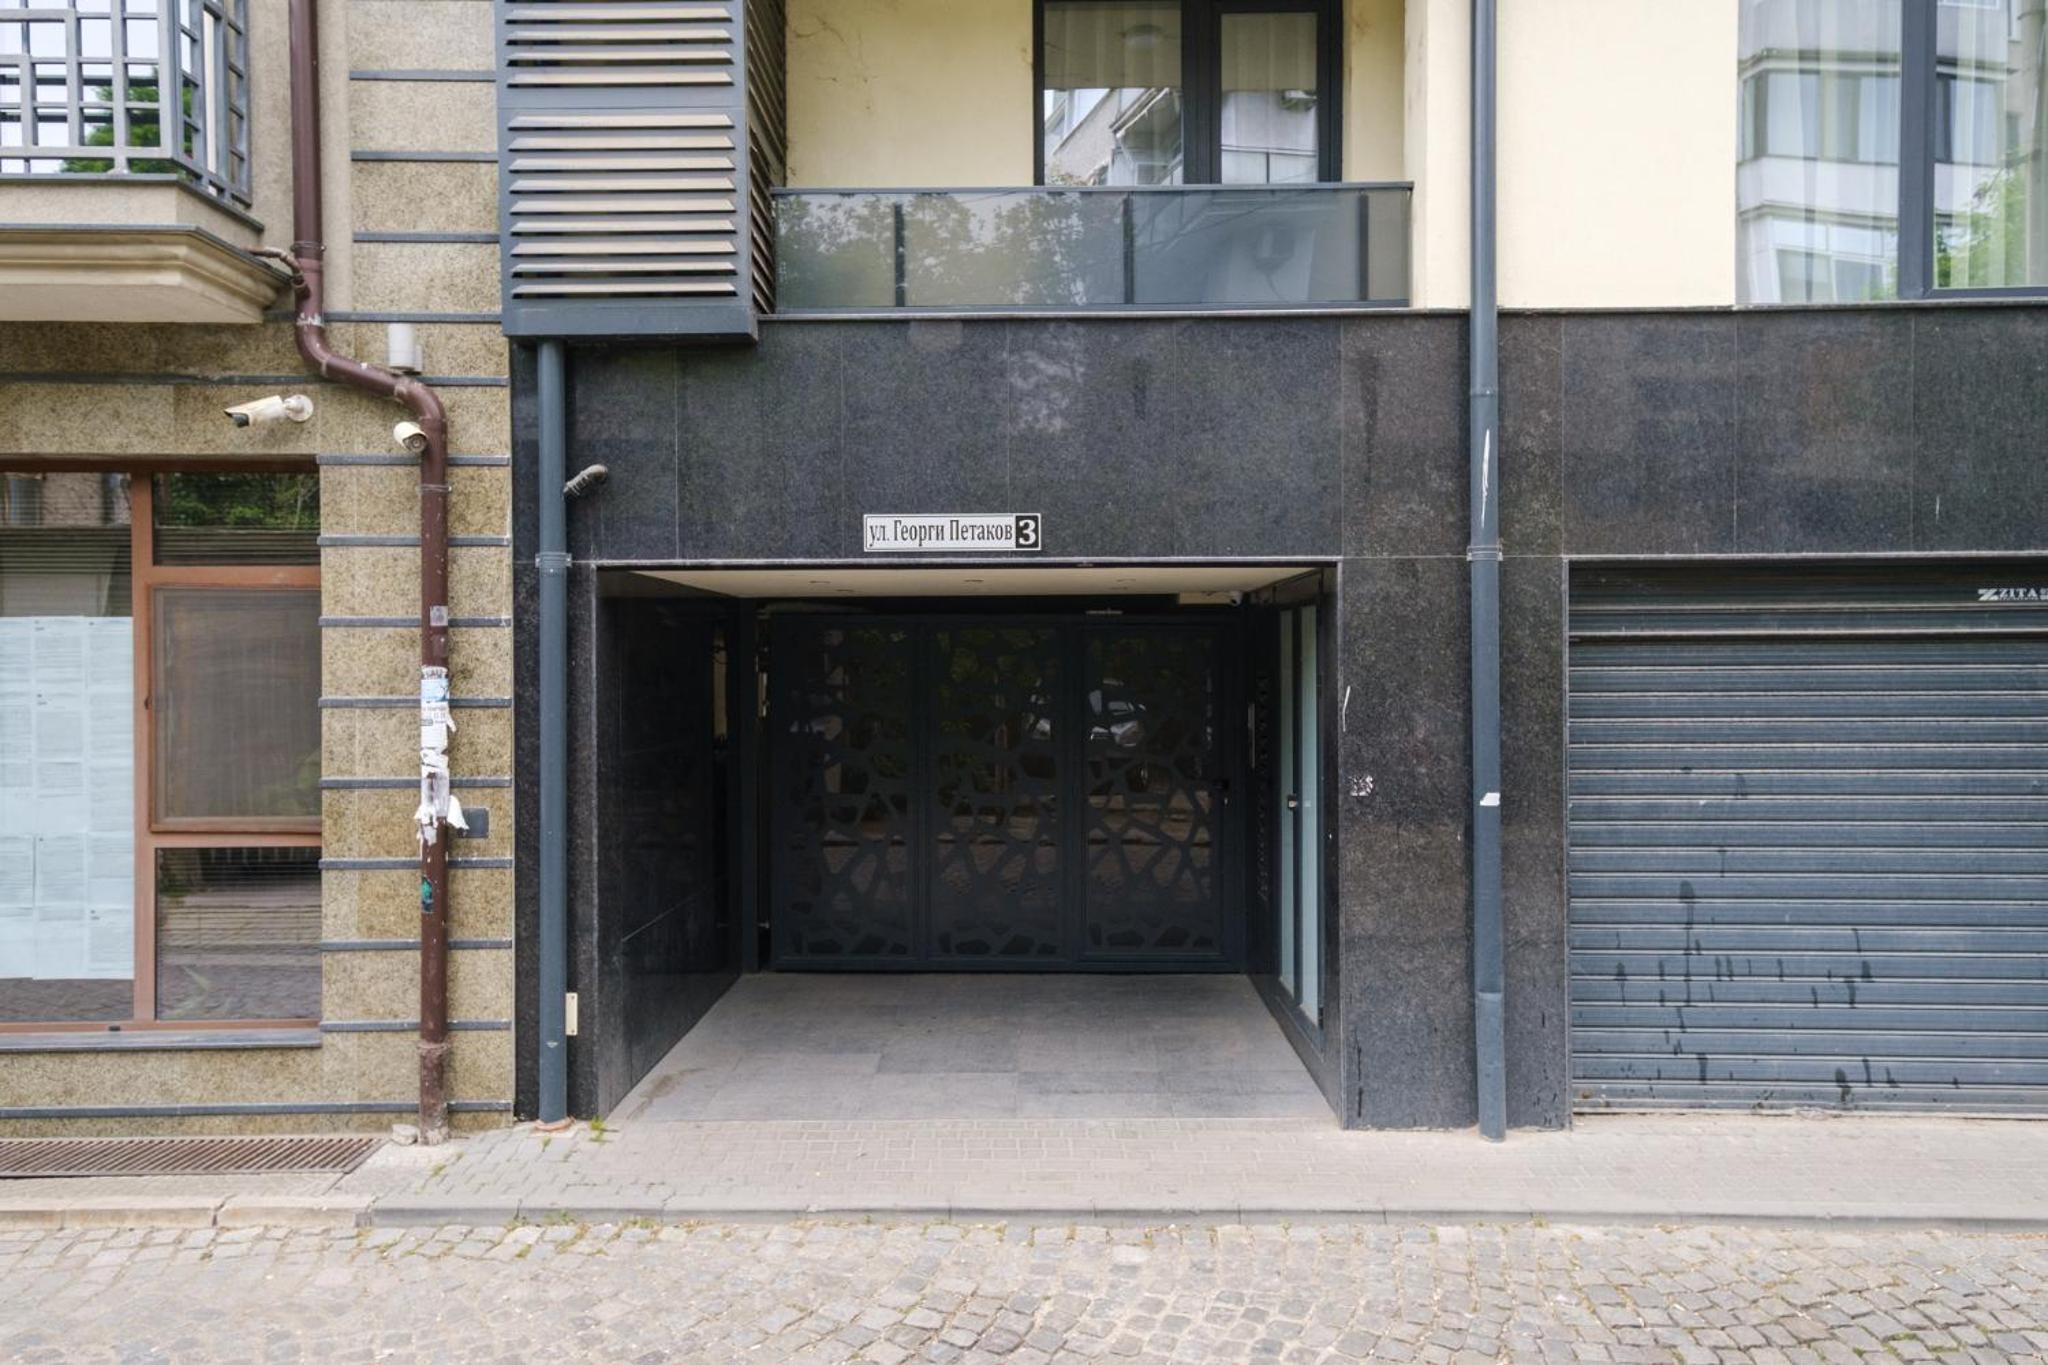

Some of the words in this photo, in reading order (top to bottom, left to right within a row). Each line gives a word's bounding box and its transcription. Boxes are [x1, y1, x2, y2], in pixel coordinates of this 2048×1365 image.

[869, 524, 890, 547] ул.
[894, 519, 944, 547] Георги
[950, 519, 1013, 541] Петаков
[1018, 519, 1037, 545] 3
